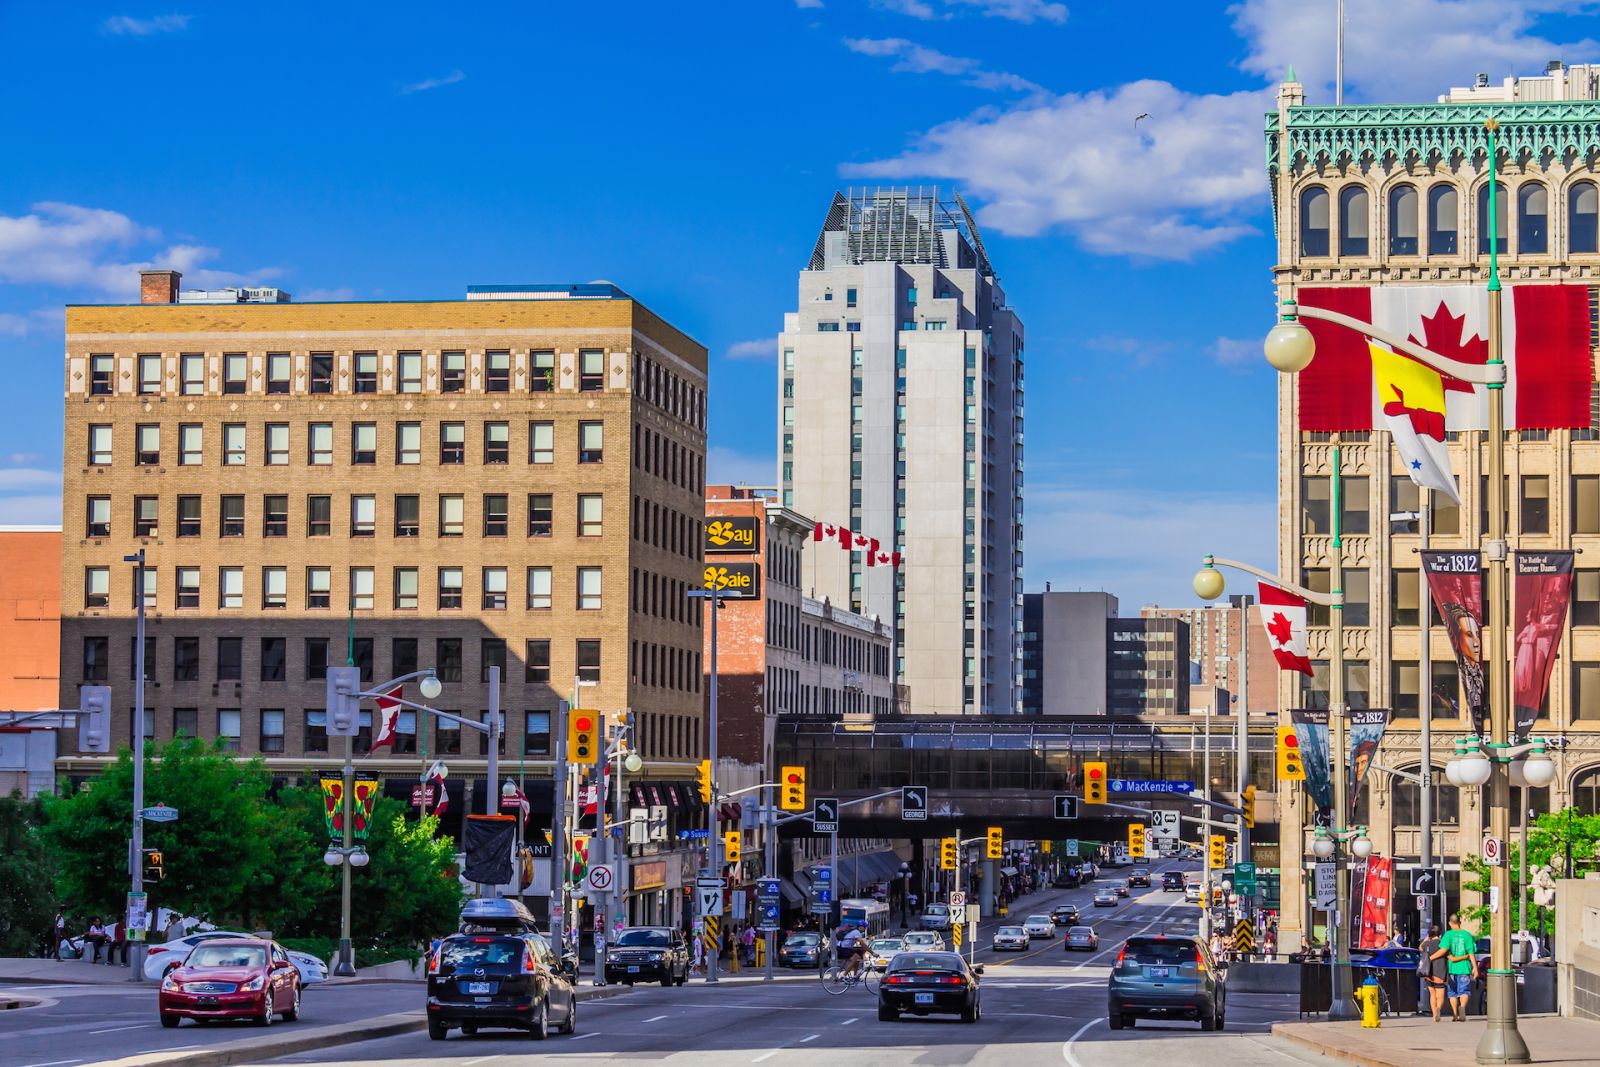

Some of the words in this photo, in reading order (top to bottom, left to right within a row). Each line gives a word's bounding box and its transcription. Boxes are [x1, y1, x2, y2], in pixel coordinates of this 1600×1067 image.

[708, 521, 753, 545] Bay
[1430, 563, 1443, 571] War
[1443, 563, 1450, 571] of
[1450, 555, 1478, 572] 1812
[703, 566, 750, 591] Baie
[1365, 712, 1383, 723] 1812
[1126, 781, 1174, 792] MacKenzie
[816, 823, 835, 831] SUSSEX
